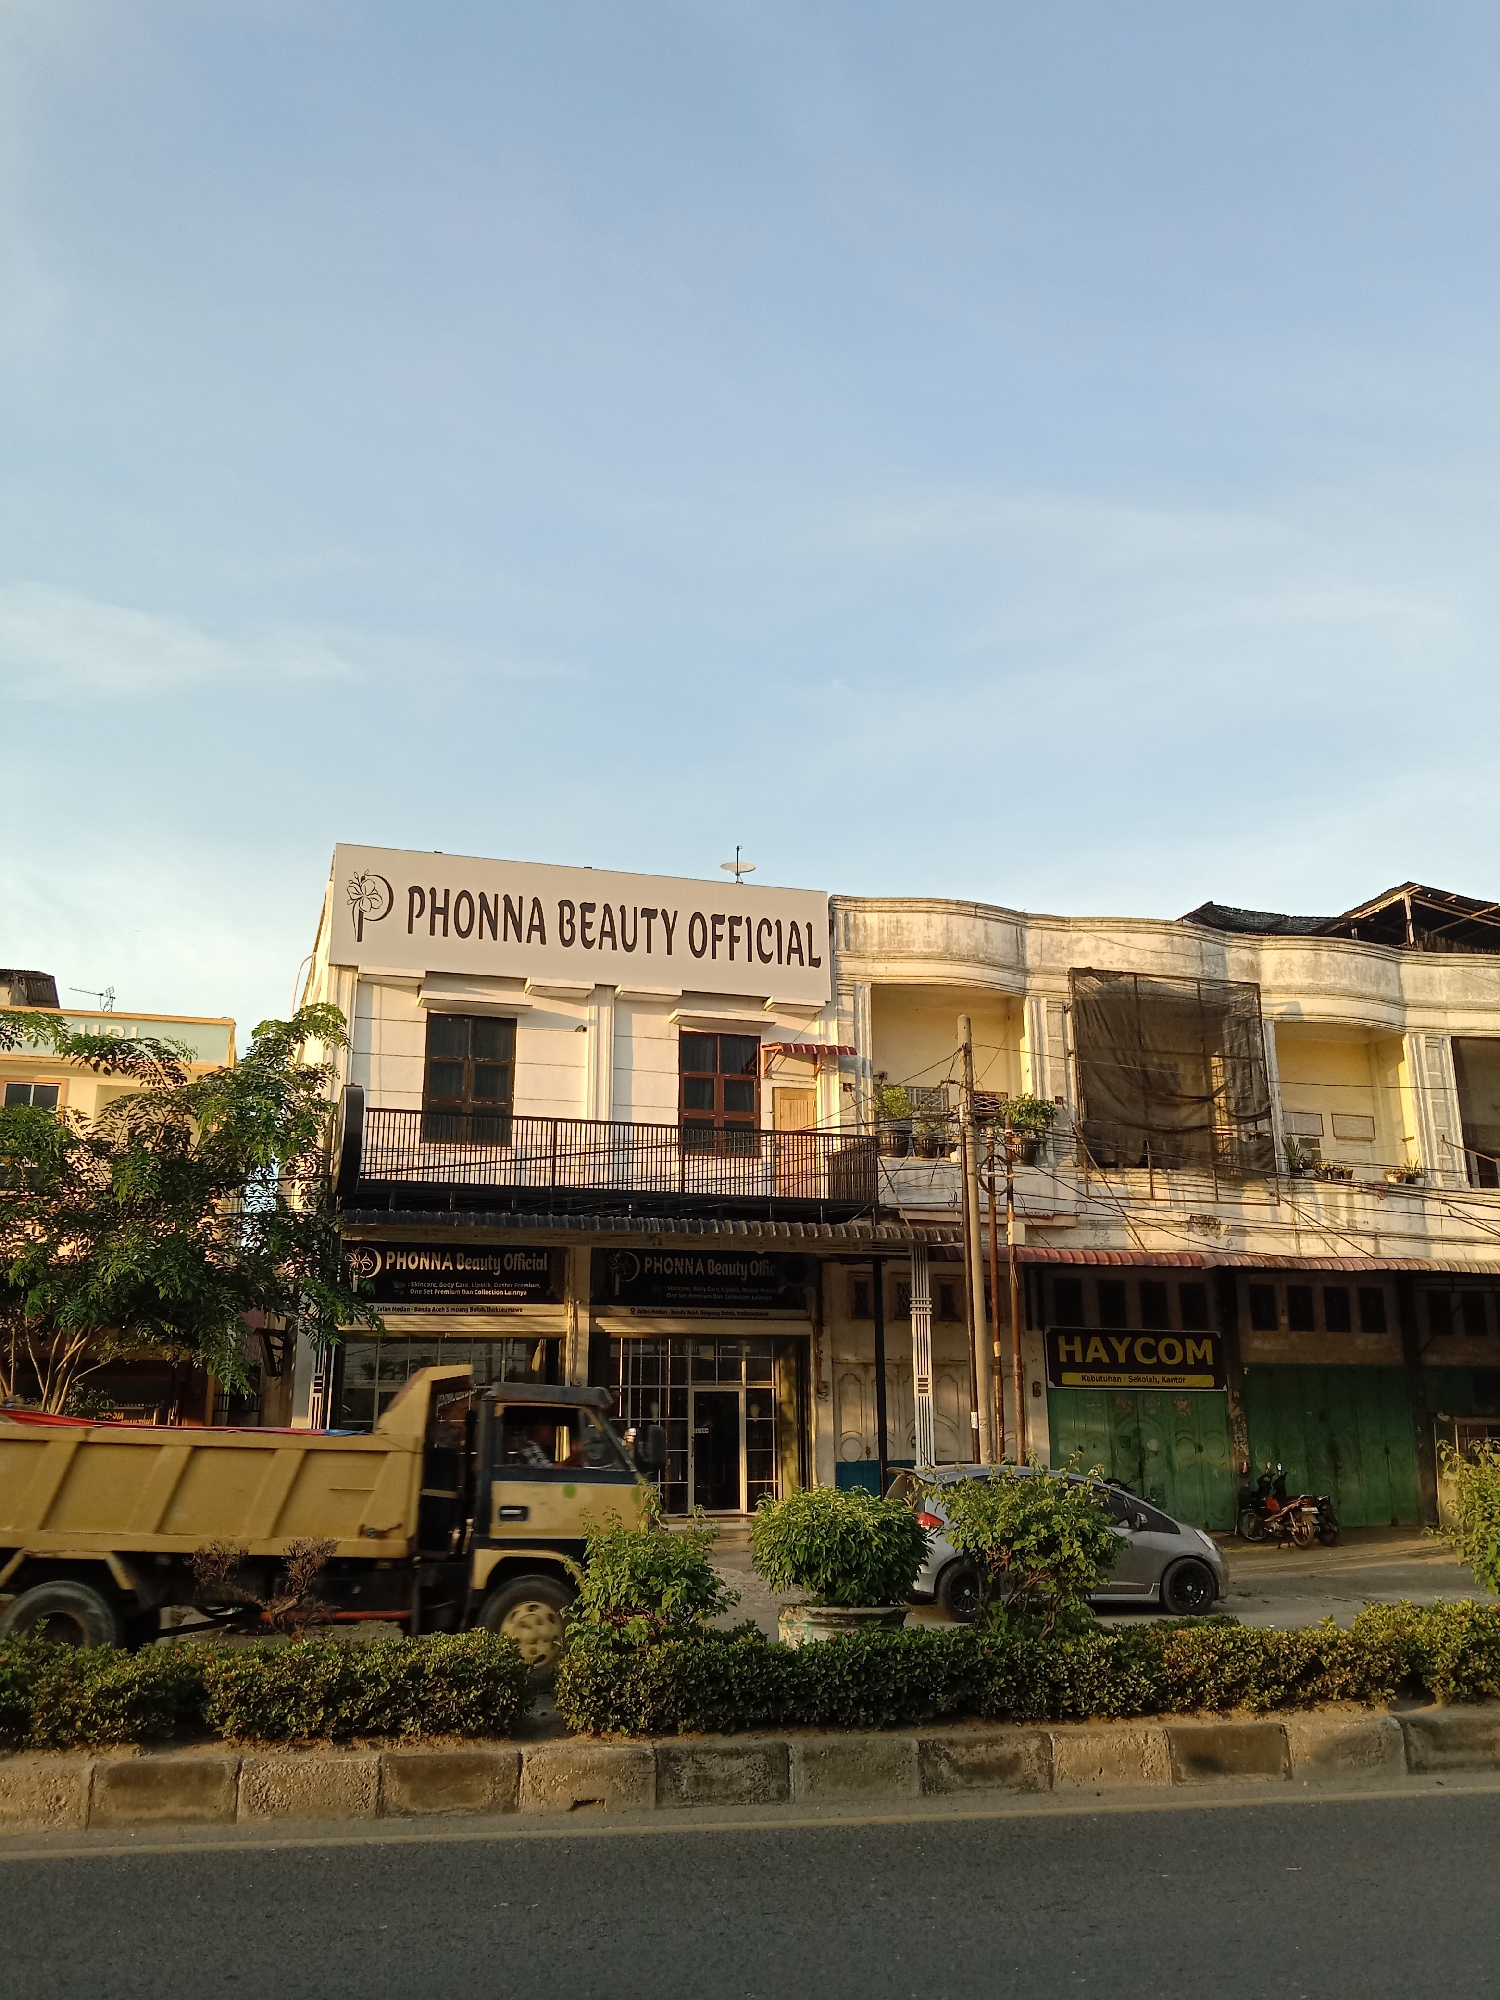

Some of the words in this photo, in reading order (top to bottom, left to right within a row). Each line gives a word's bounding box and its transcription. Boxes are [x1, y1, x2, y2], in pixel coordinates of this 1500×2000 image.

[407, 885, 547, 945] PHONNA
[557, 899, 679, 956] BEAUTY
[688, 911, 822, 969] OFFICIAL
[385, 1251, 454, 1270] PHONNA
[456, 1252, 501, 1276] Beauty
[503, 1252, 548, 1271] Official
[644, 1255, 705, 1275] PHONNA
[707, 1258, 748, 1281] Beauty
[504, 1289, 527, 1297] Lainnya
[1057, 1335, 1214, 1365] HAYCOM
[1081, 1374, 1122, 1383] Kebutuhan
[1128, 1375, 1160, 1384] Sekolah,
[1161, 1375, 1186, 1384] Kantor
